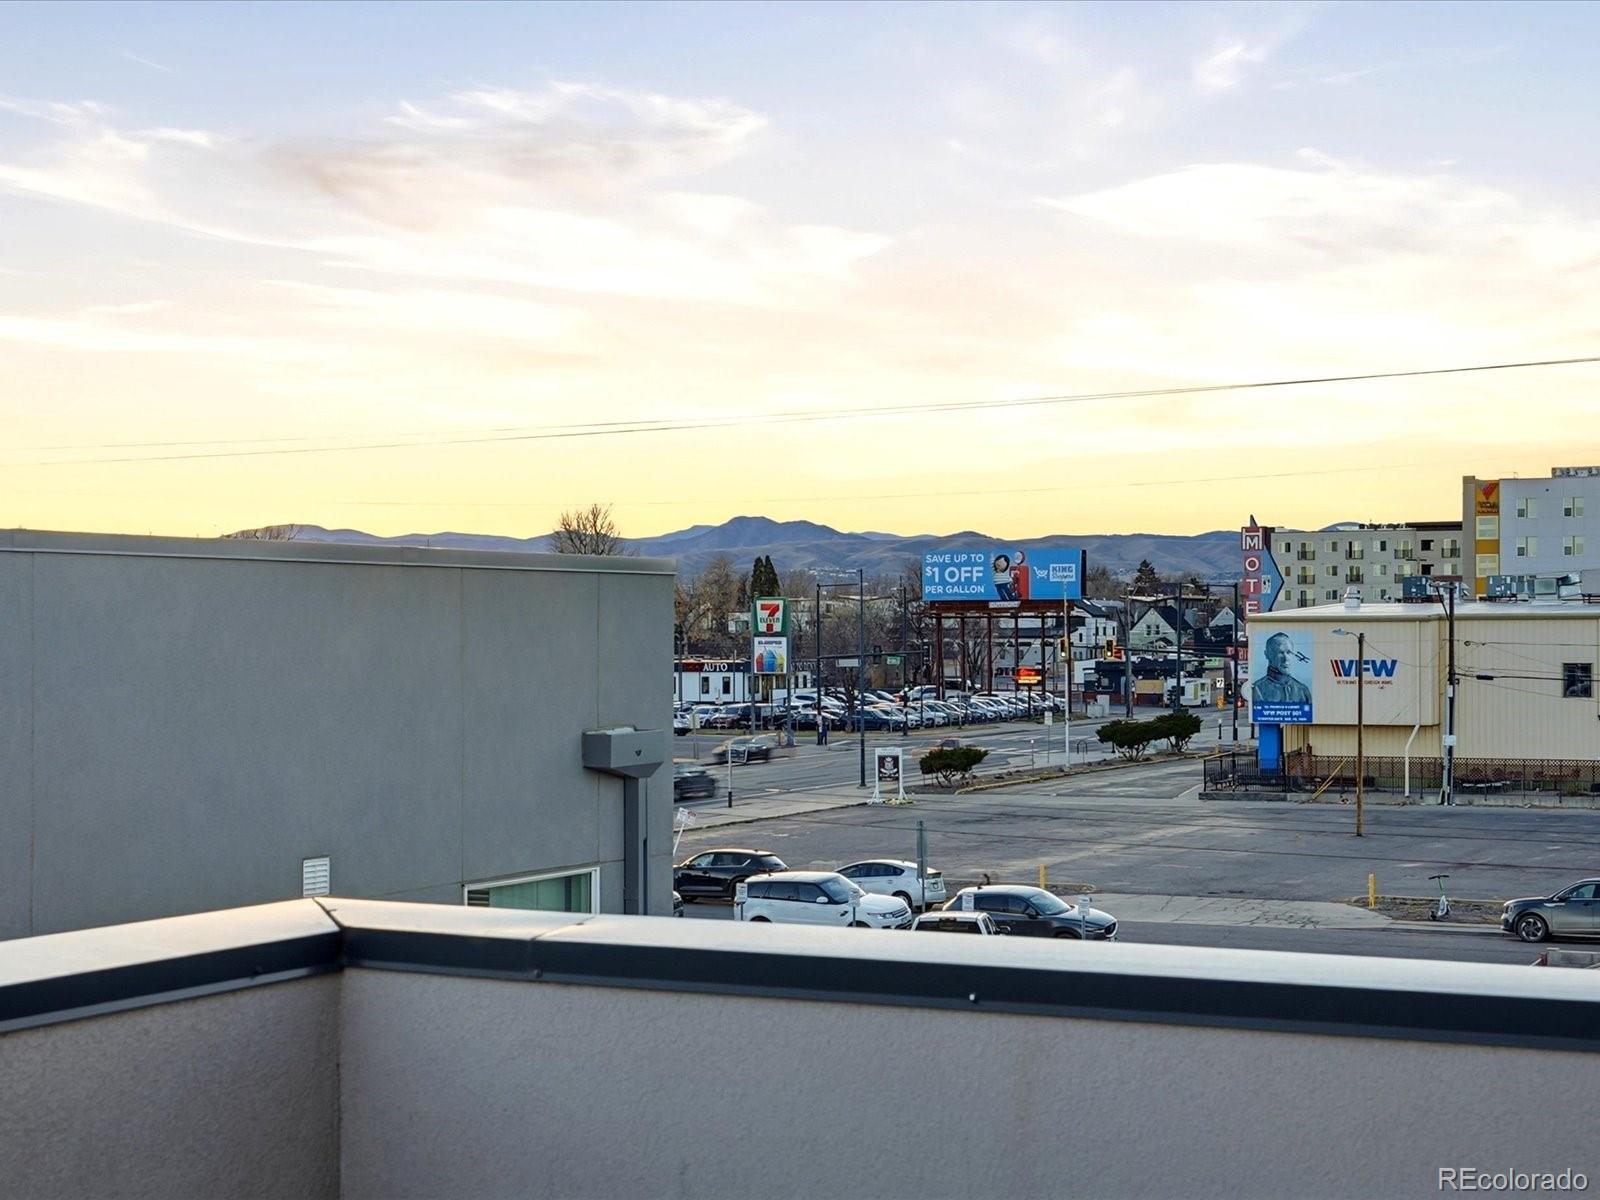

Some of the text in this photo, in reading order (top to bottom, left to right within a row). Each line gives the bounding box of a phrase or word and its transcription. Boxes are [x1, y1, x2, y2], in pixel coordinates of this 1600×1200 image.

[925, 553, 984, 563] SAVE UP TO
[1051, 565, 1073, 573] KING
[925, 566, 984, 583] $1 OFF
[925, 585, 985, 594] PER GALLON
[760, 603, 780, 632] 7
[702, 663, 728, 672] AUTO
[1338, 659, 1398, 677] VFW
